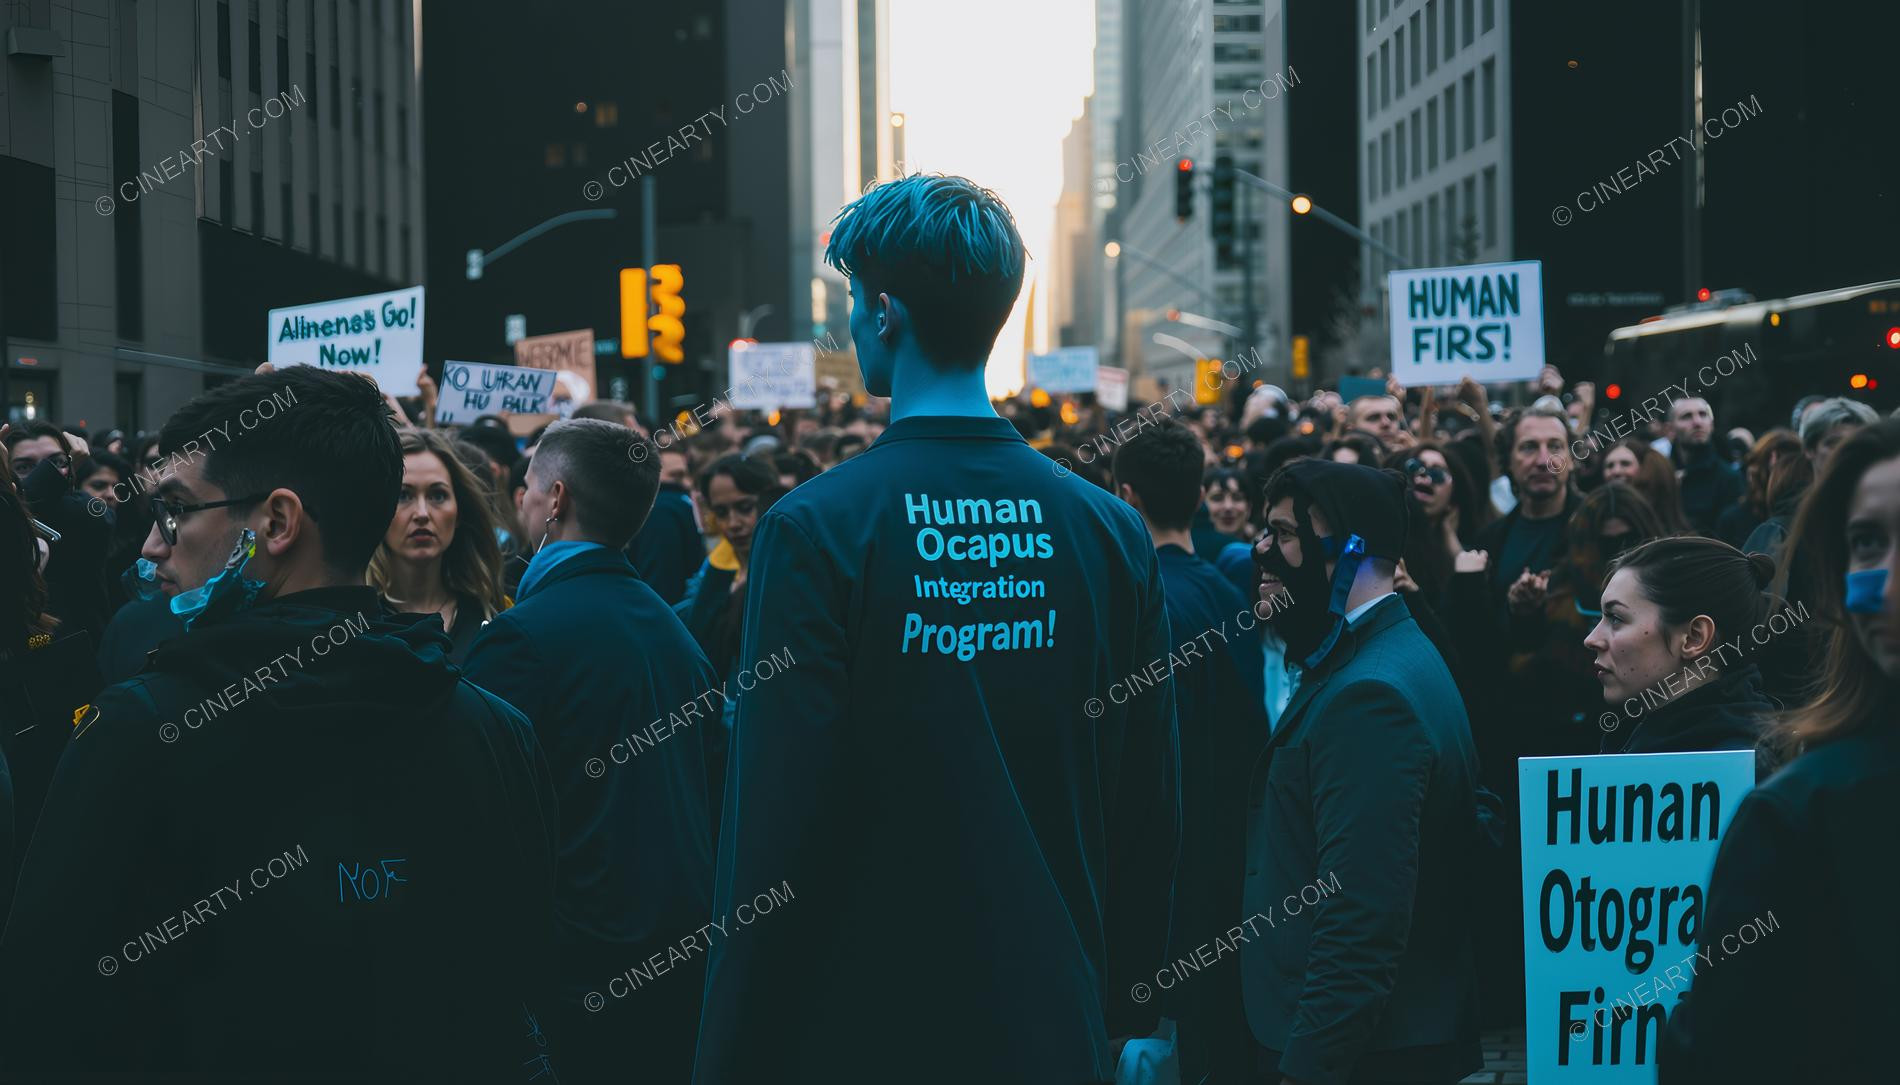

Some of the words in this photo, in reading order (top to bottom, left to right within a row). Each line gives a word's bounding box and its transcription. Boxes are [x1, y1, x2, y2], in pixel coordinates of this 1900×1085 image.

[381, 297, 416, 329] Go!
[1408, 272, 1521, 319] HUMAN
[319, 338, 381, 366] Now!
[1412, 322, 1512, 363] FIRS!
[904, 493, 1043, 525] Human
[916, 527, 1054, 568] Ocapus
[914, 574, 1045, 605] Integration
[901, 609, 1056, 662] Program!
[1546, 767, 1721, 845] Hunan
[1558, 986, 1690, 1067] Firn
